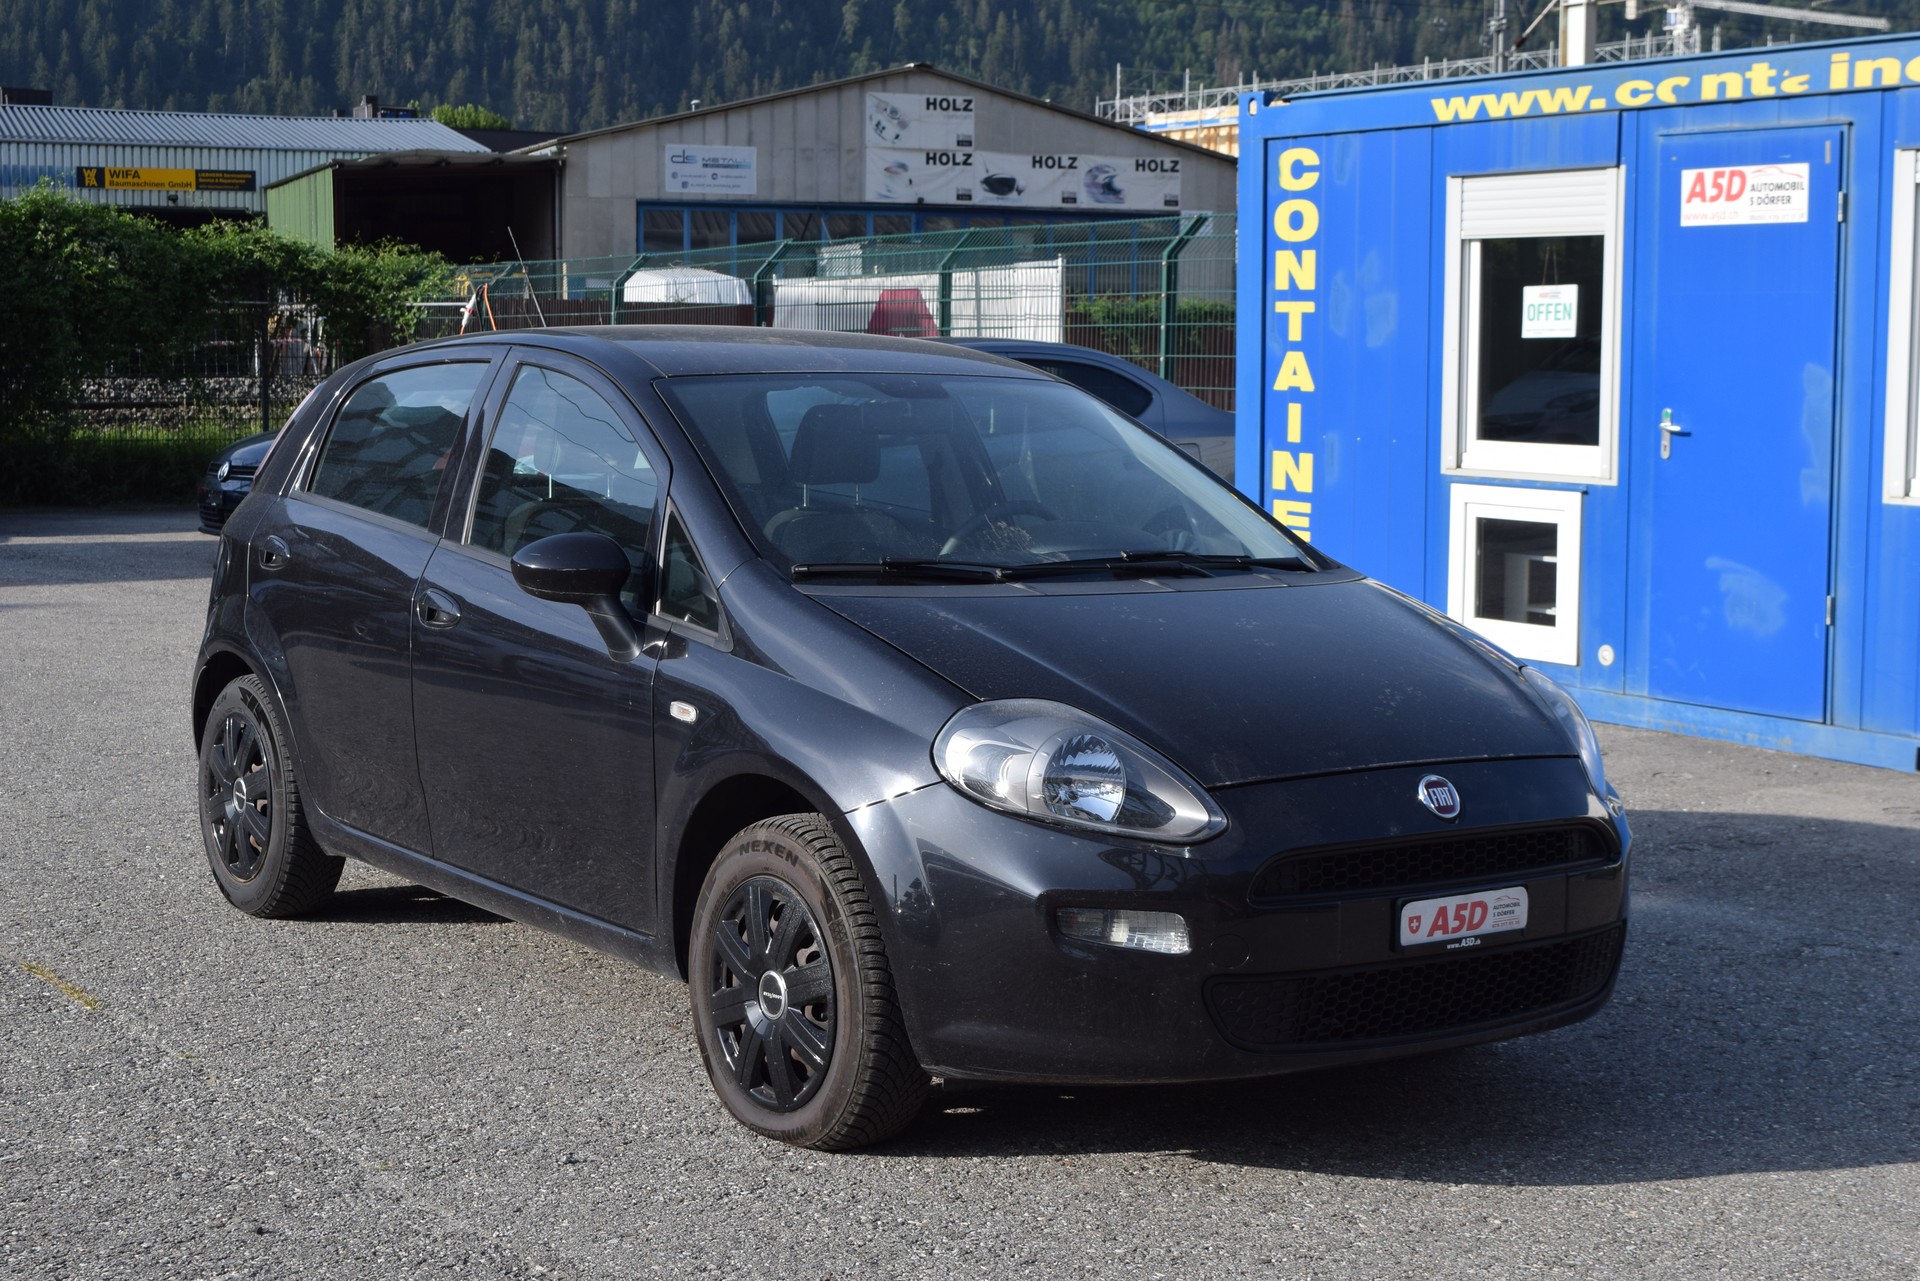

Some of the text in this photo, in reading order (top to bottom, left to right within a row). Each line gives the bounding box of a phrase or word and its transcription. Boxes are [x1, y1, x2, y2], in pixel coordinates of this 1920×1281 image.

[926, 97, 973, 112] HOLZ
[926, 152, 973, 166] HOLZ
[1032, 155, 1078, 169] HOLZ
[1135, 159, 1180, 173] HOLZ
[109, 169, 140, 179] WIFA
[109, 180, 165, 188] Baumaschinen
[168, 181, 192, 189] GmbH
[1685, 169, 1747, 204] A5D
[1750, 181, 1805, 192] AUTOMOBIL
[1757, 194, 1792, 206] DÖRFER
[1527, 303, 1572, 321] OFFEN
[1428, 786, 1453, 807] FIAT
[739, 840, 800, 868] NEXEN
[1493, 902, 1520, 910] AUTOMOBIL
[1426, 900, 1488, 937] A5D
